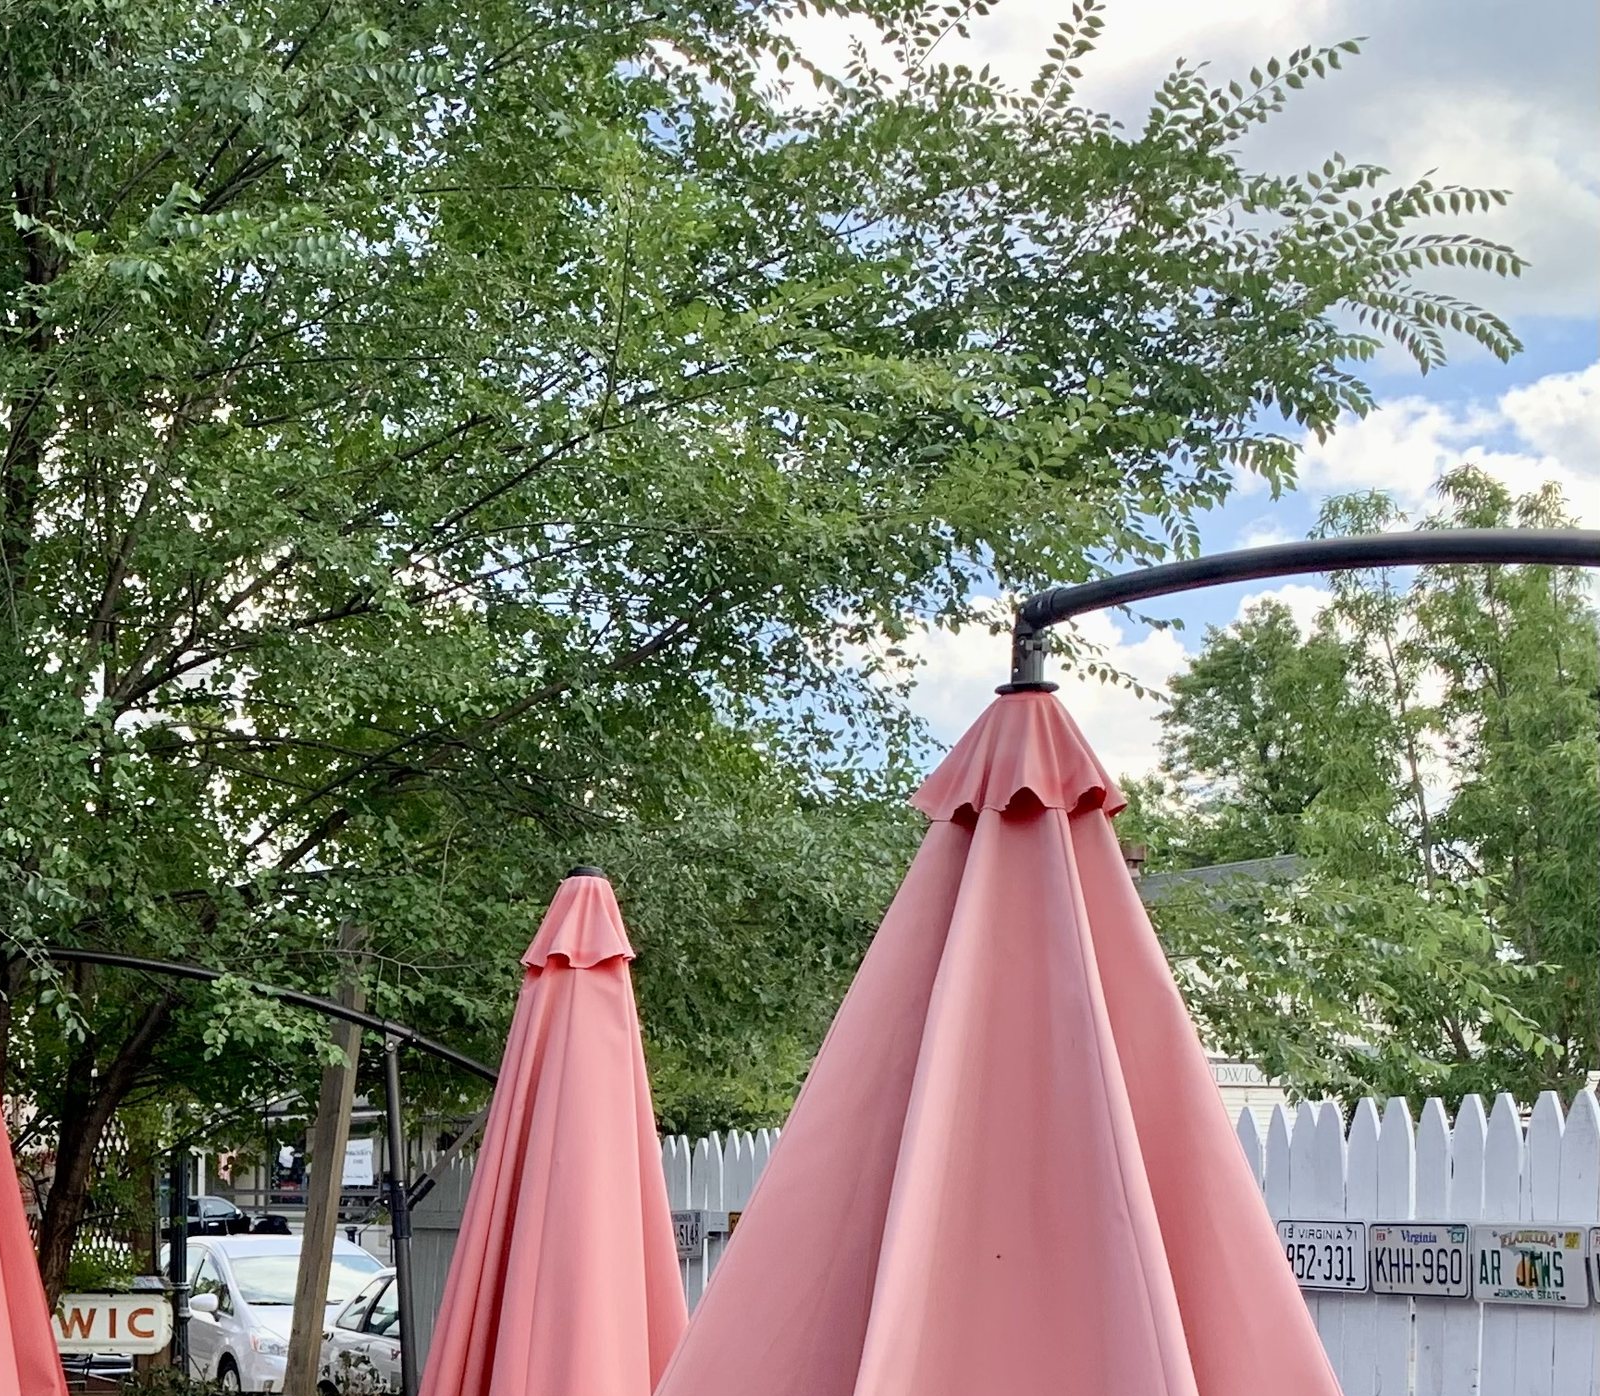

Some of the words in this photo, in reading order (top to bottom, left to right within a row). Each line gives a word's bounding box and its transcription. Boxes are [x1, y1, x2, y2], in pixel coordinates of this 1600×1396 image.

[1213, 1067, 1263, 1082] DWIC
[1298, 1228, 1343, 1240] VIRGINIA
[1401, 1229, 1437, 1246] Virginia
[1375, 1247, 1462, 1285] KHH-960
[1479, 1250, 1501, 1285] AR
[1516, 1250, 1564, 1288] JAWS
